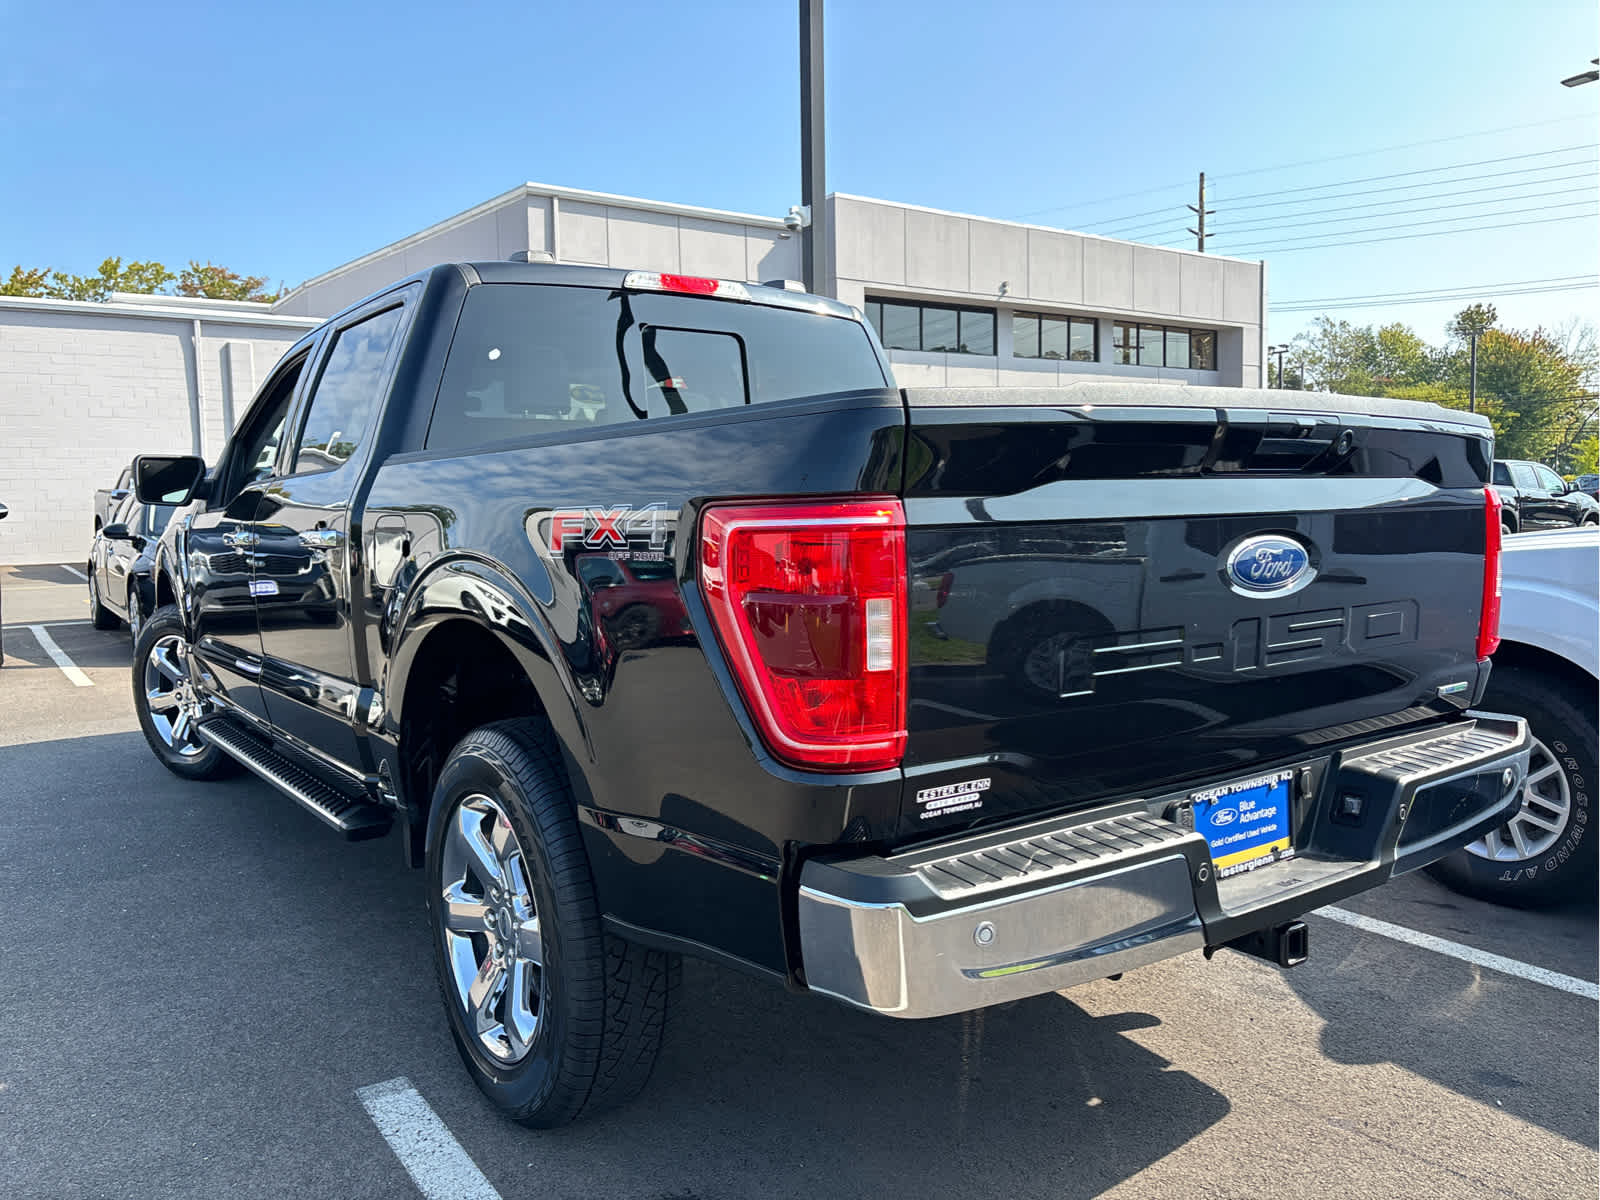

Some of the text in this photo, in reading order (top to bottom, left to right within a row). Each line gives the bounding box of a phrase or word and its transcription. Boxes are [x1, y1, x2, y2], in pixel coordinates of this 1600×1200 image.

[550, 502, 668, 559] FX4
[608, 551, 631, 561] OFF
[1250, 547, 1293, 580] Ford
[1059, 599, 1420, 698] F-150
[918, 779, 991, 801] LESTER GLENN
[1195, 770, 1293, 802] OCEAN TOWNSHIP NJ
[920, 809, 941, 819] OCEAN
[1215, 811, 1233, 823] Ford
[1239, 800, 1256, 812] Blue
[1240, 806, 1277, 824] Advantage
[1499, 740, 1589, 882] CROSSWIND A/T
[1211, 837, 1224, 848] Gold
[1224, 831, 1247, 844] Certified
[1260, 824, 1278, 834] Vehicle
